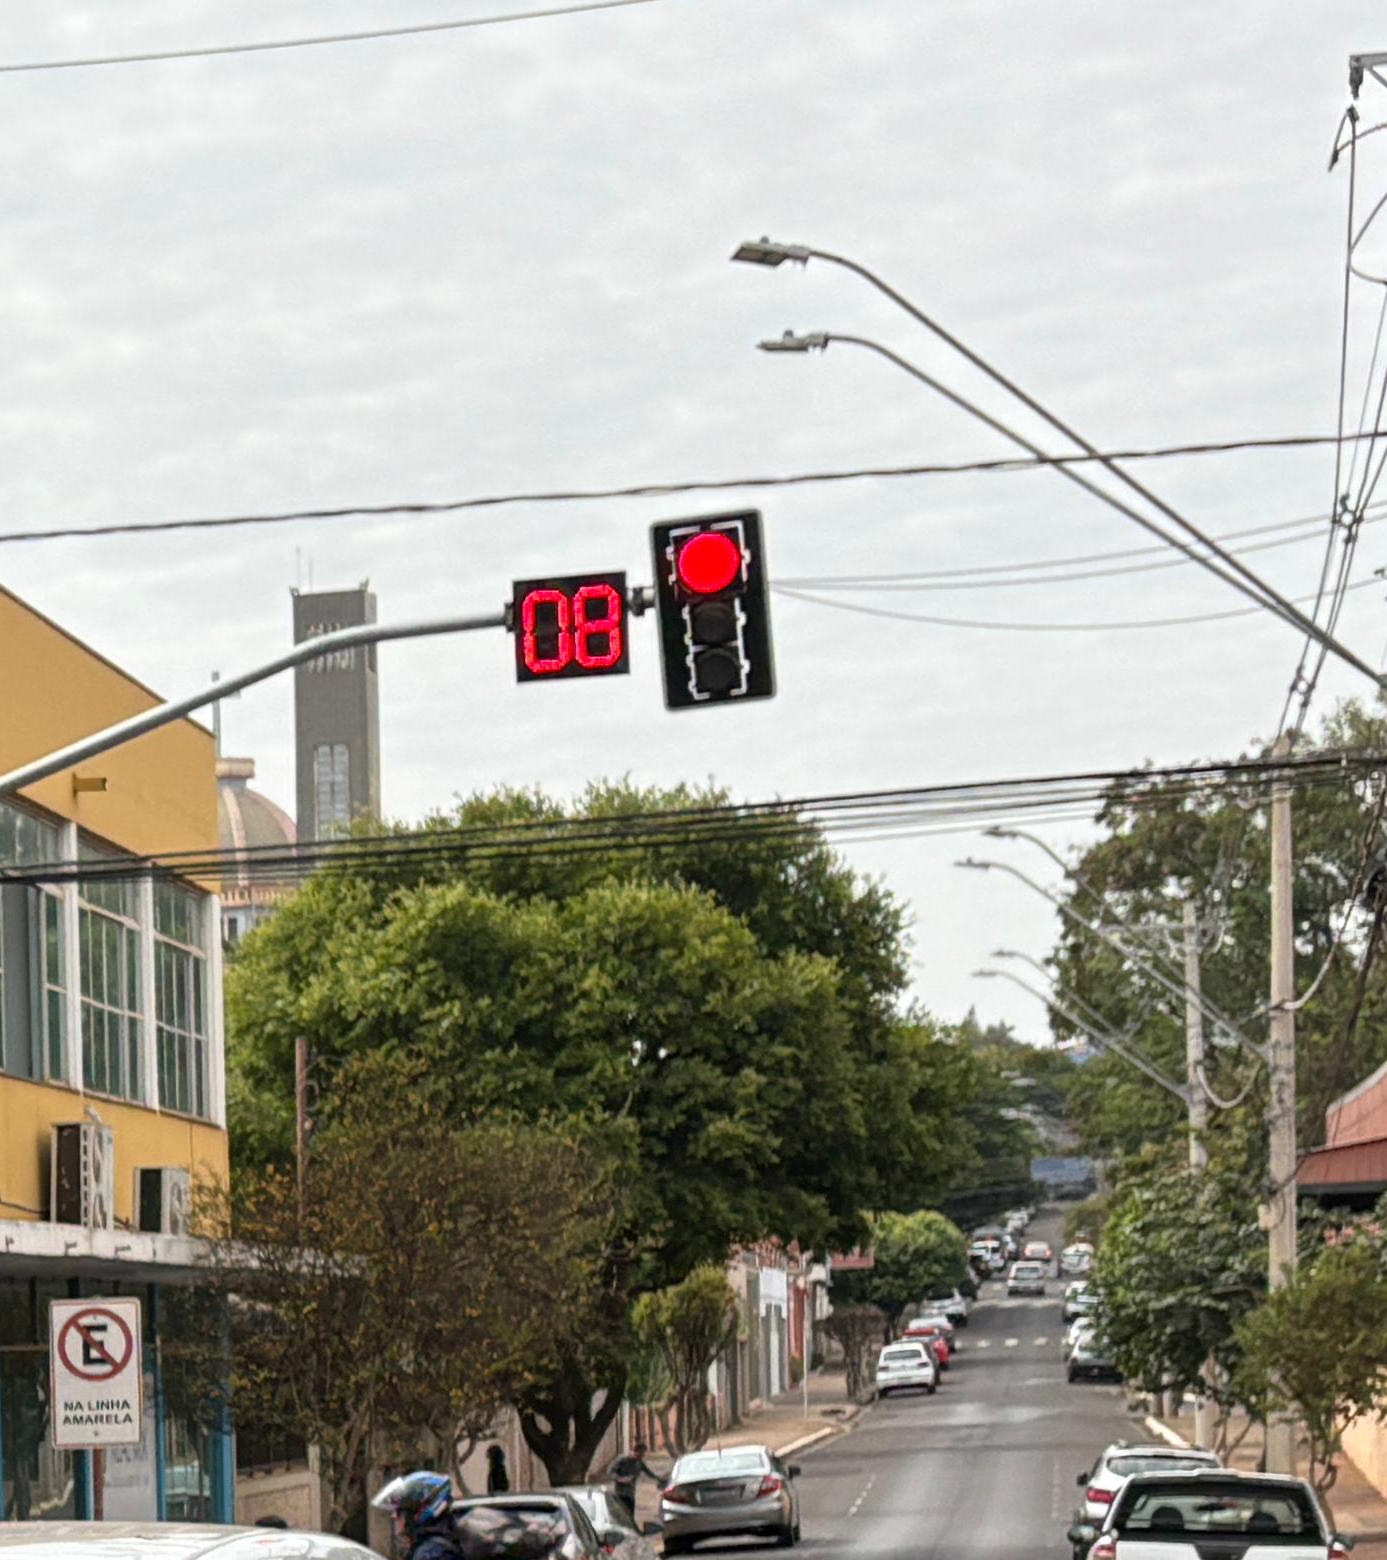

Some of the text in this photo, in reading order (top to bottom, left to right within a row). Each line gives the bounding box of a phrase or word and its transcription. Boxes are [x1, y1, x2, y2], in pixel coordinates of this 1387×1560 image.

[522, 584, 623, 675] 08
[63, 1399, 131, 1412] NA LINHA
[62, 1413, 133, 1425] AMARELA
